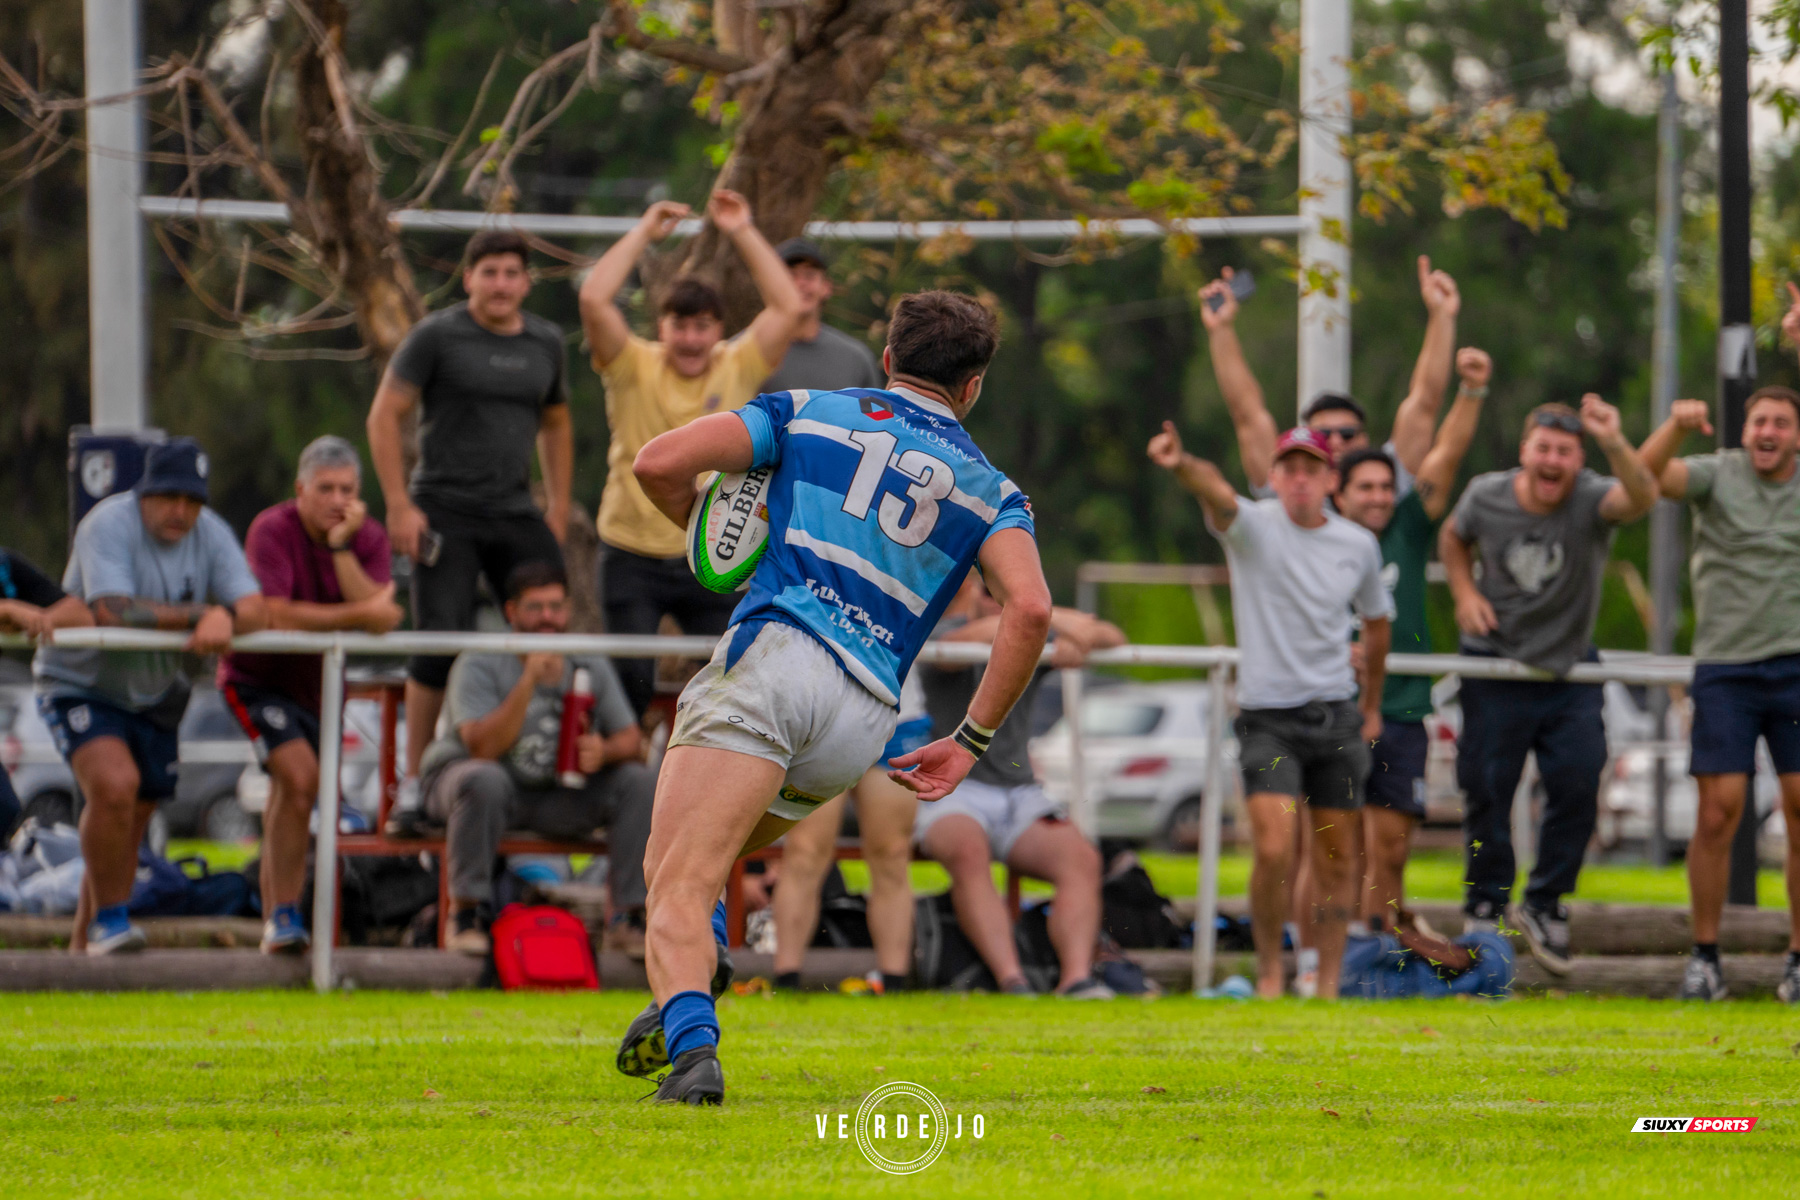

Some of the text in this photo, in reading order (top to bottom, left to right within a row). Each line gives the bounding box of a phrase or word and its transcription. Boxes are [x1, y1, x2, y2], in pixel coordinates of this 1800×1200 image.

[895, 416, 978, 466] AUTOSANZ
[716, 467, 771, 561] GILBER
[841, 430, 956, 548] 13
